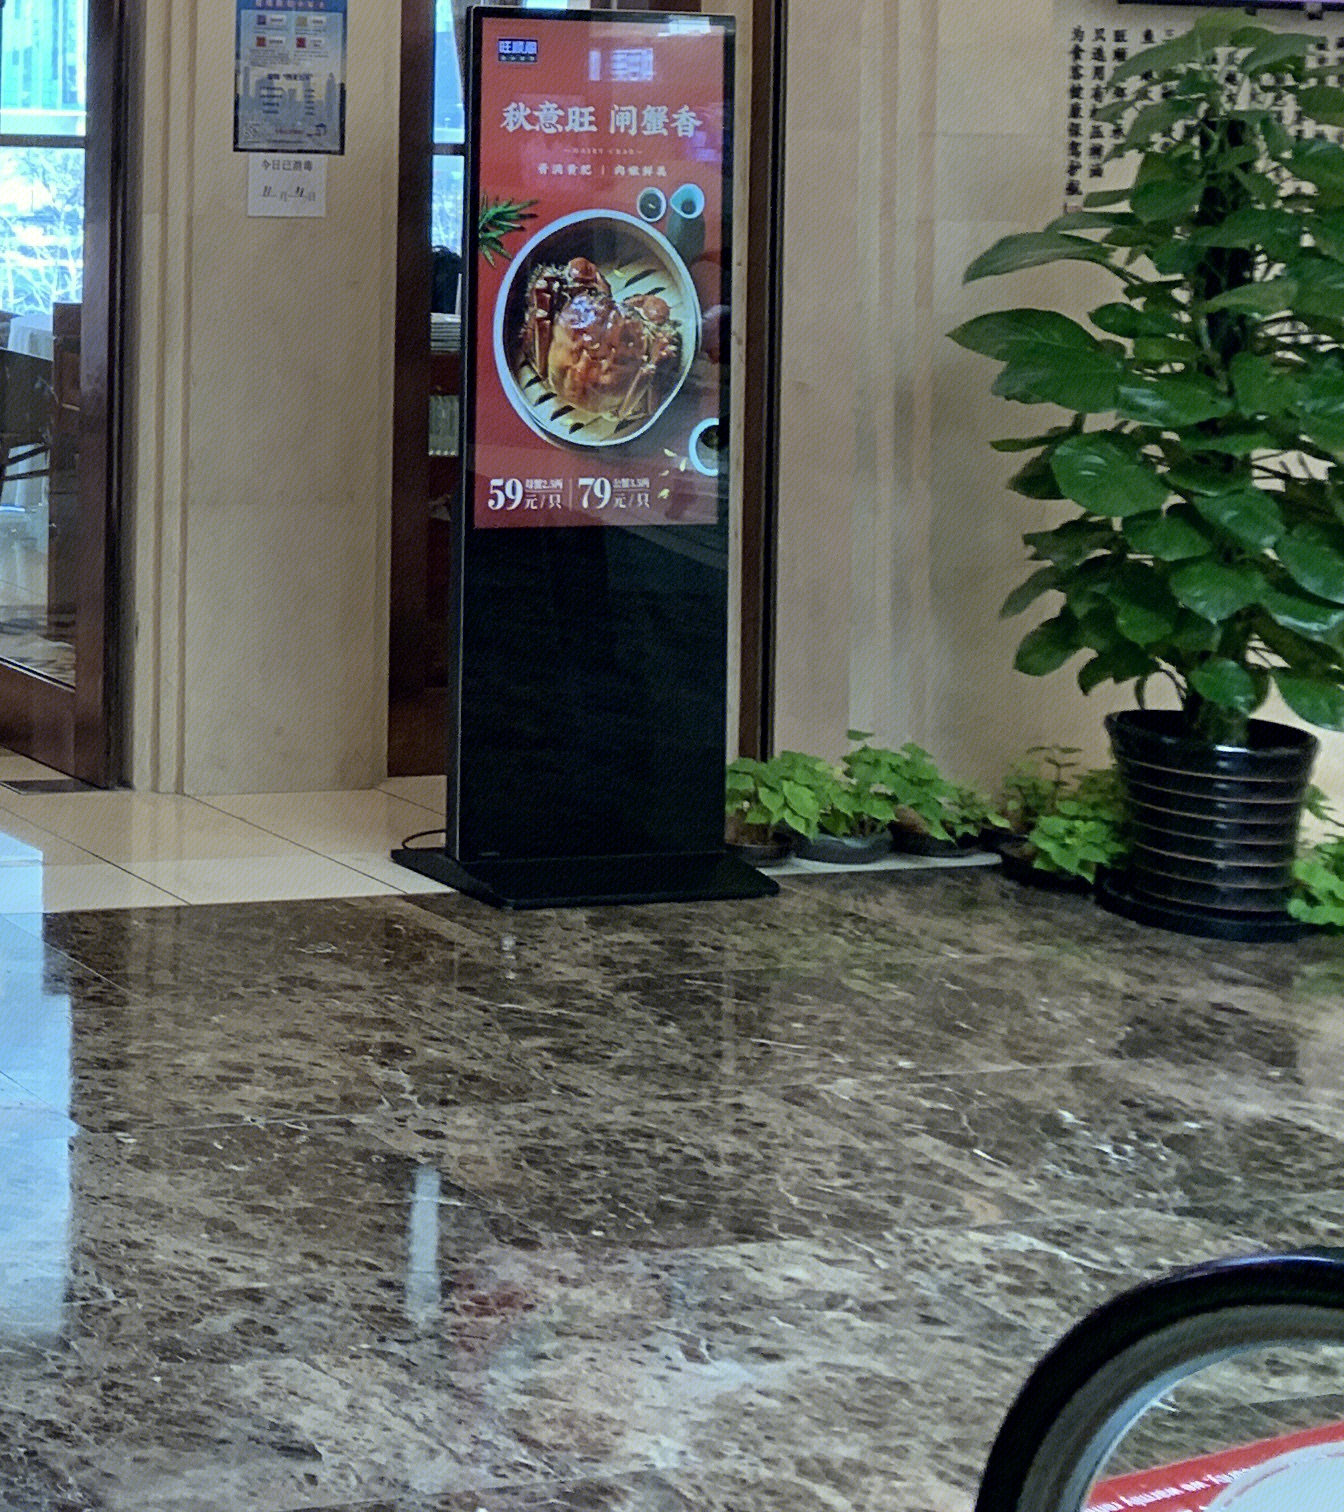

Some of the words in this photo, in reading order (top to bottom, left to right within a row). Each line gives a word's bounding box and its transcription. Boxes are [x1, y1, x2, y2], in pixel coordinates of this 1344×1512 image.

[499, 100, 598, 134] 秋意旺
[609, 104, 703, 138] 闸蟹香
[488, 477, 524, 511] 59
[578, 476, 612, 510] 79
[524, 493, 563, 510] 元/只
[612, 492, 651, 509] 元/只
